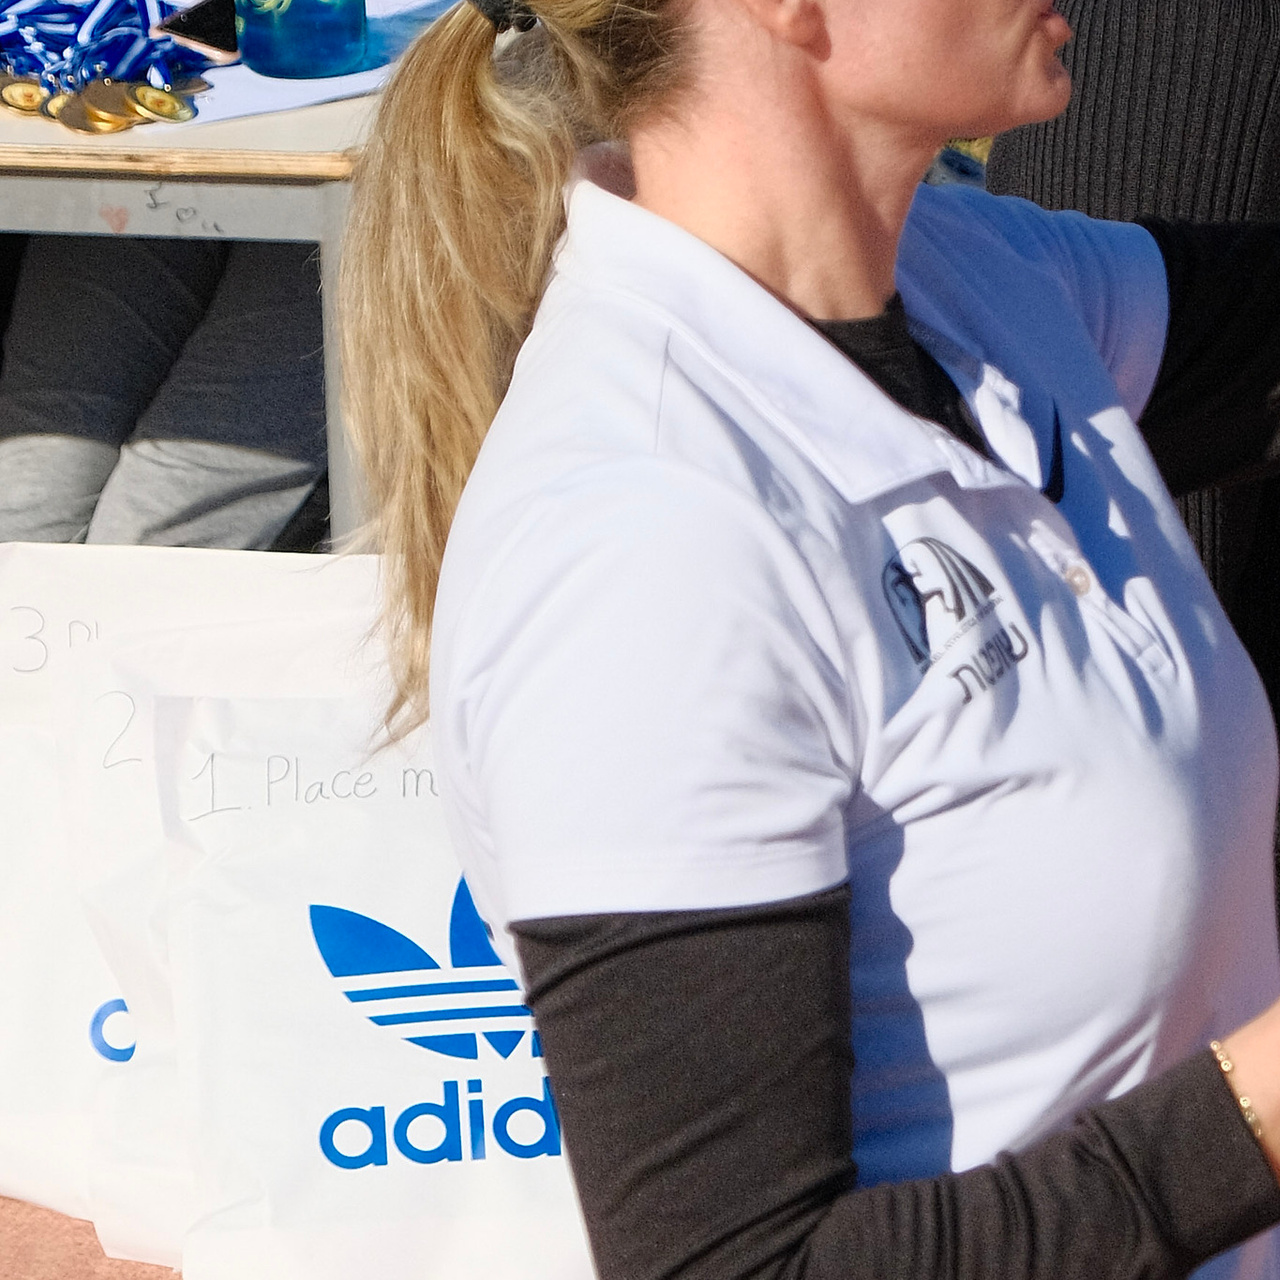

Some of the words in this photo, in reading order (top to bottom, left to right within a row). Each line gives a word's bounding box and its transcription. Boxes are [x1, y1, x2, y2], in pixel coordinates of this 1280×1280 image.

[10, 605, 48, 673] 3
[95, 690, 142, 769] 2
[266, 755, 378, 805] Place
[319, 1075, 562, 1171] adid
